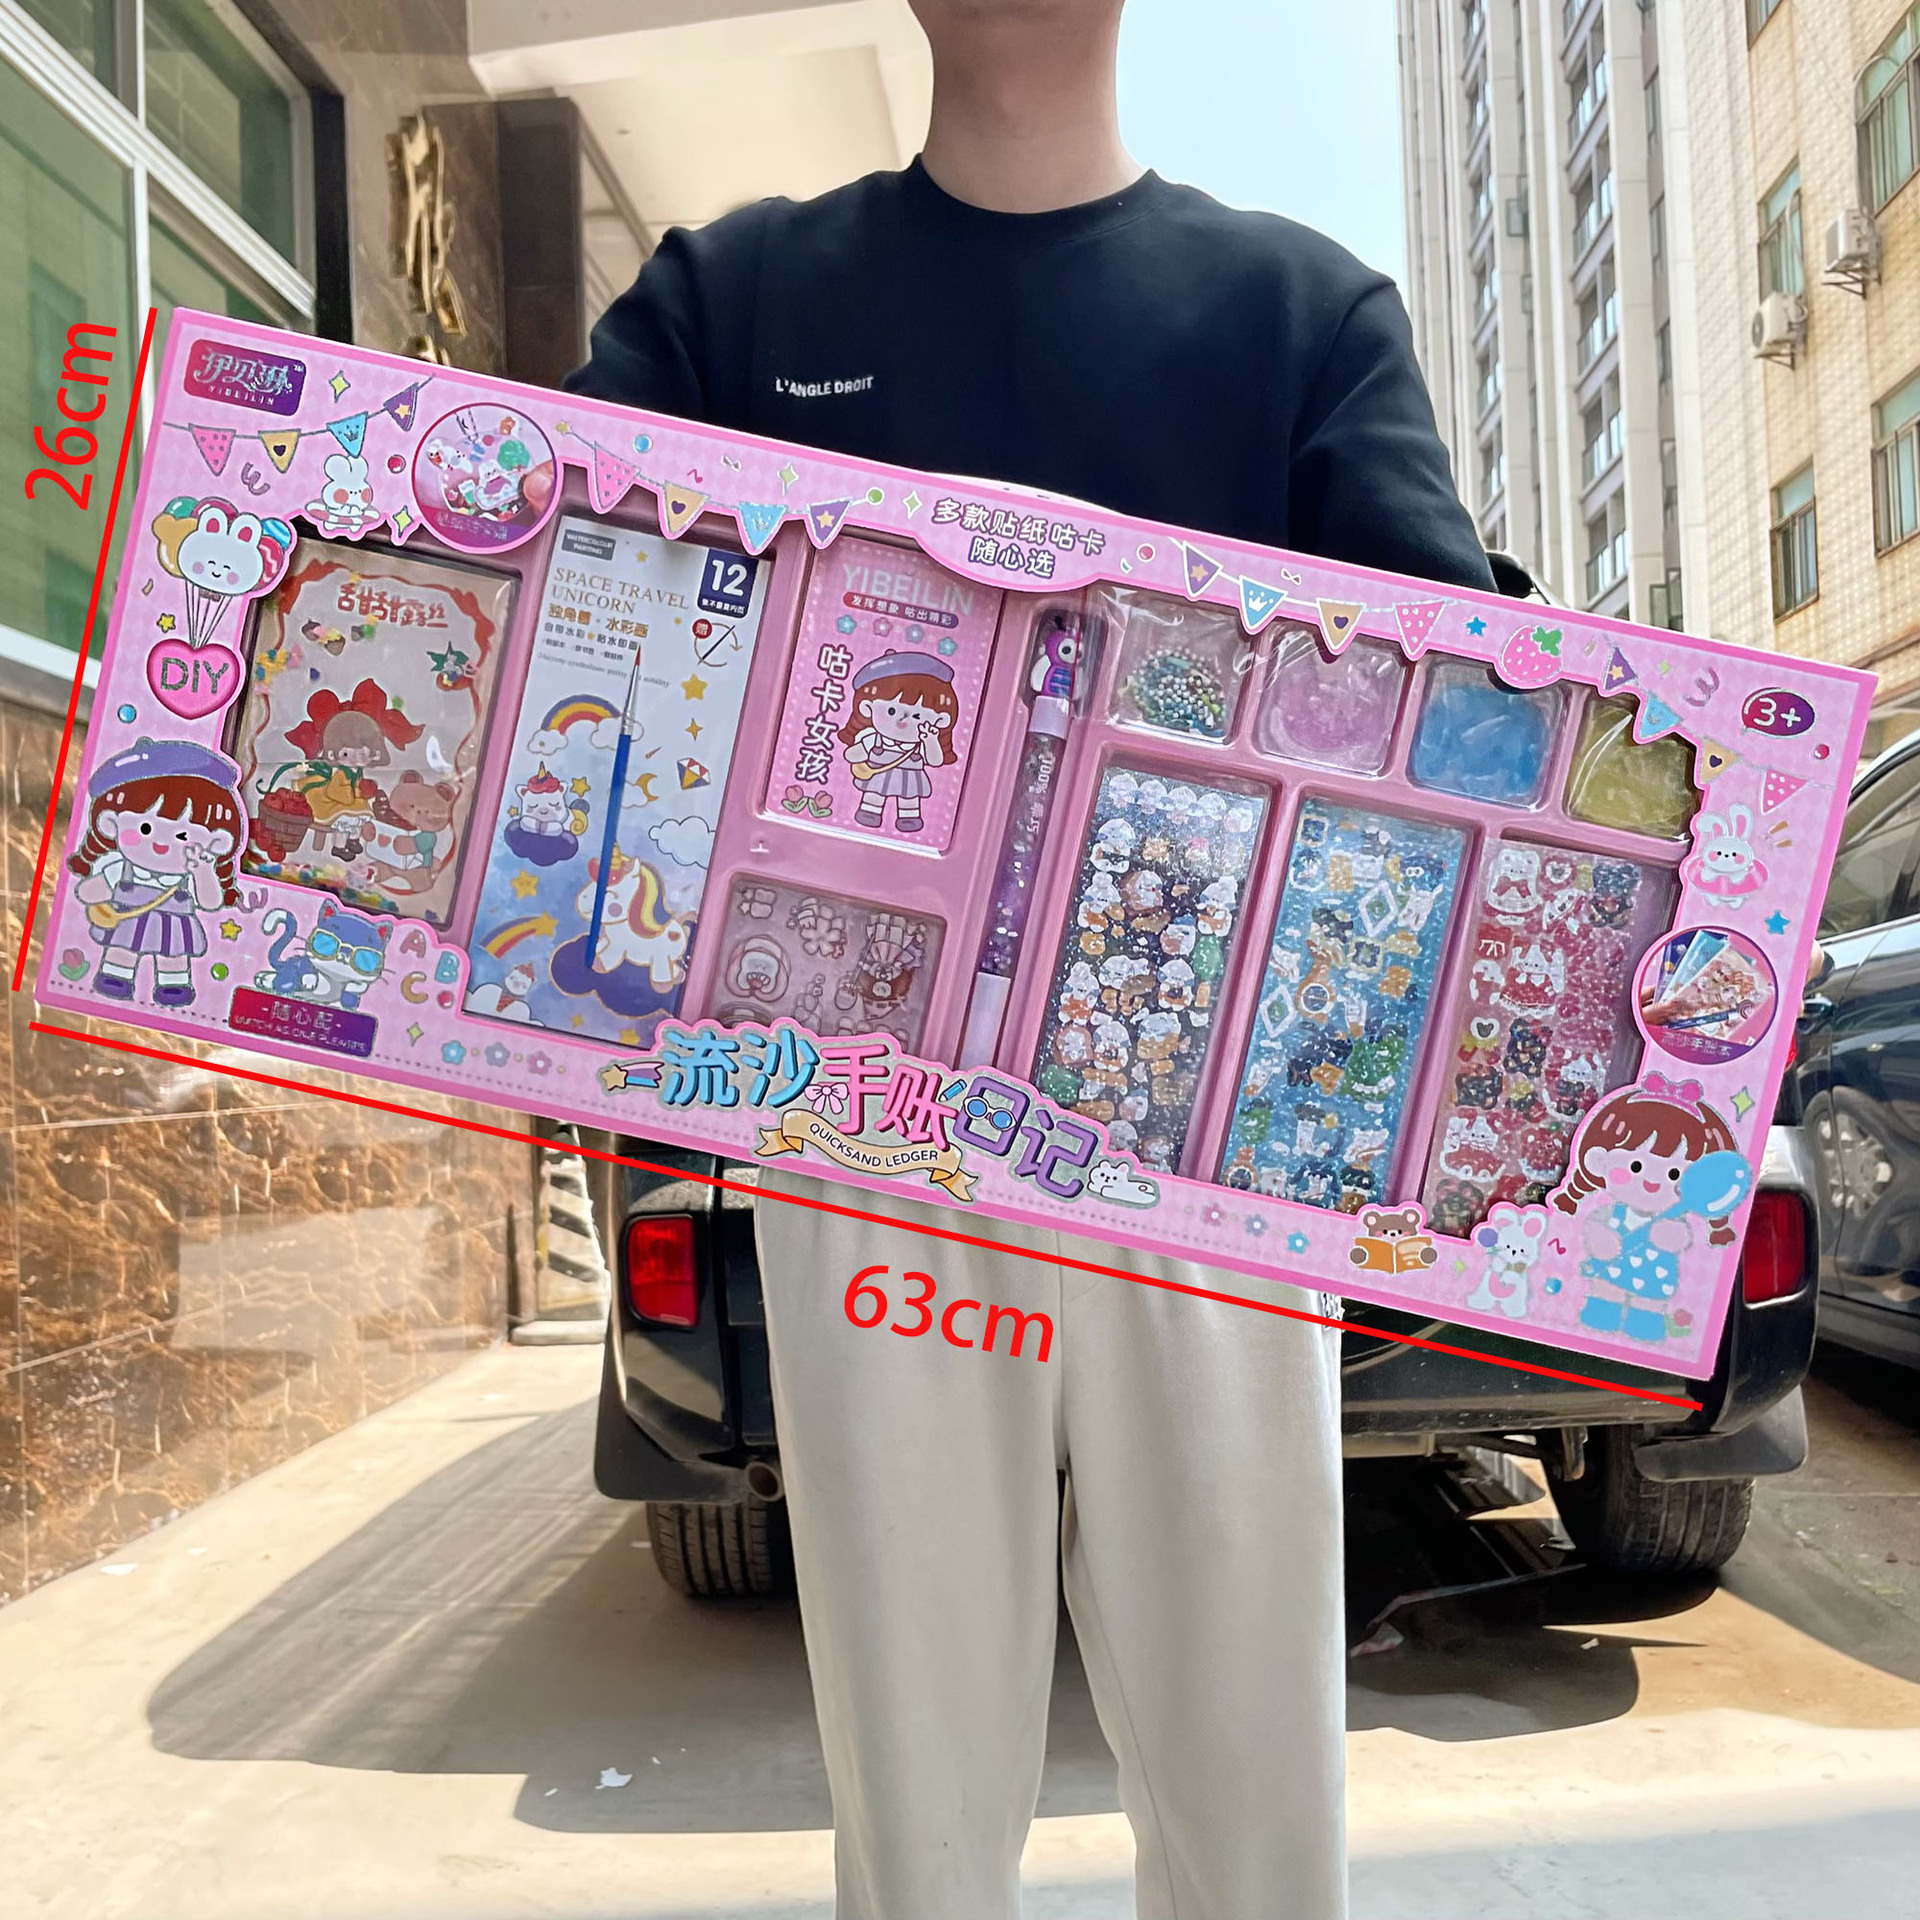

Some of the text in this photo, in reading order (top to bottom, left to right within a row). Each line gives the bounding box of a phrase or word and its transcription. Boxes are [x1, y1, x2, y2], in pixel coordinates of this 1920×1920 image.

[775, 376, 873, 397] L'ANGLE DROIT
[932, 498, 1106, 555] 多款贴纸咕卡
[712, 559, 747, 596] 12
[969, 537, 1054, 579] 随心选
[551, 585, 636, 615] UNICORN
[553, 567, 690, 610] SPACE TRAVEL
[843, 563, 974, 616] YIBEILIN
[160, 657, 230, 694] DIY
[795, 643, 853, 785] 咕卡女孩
[1752, 696, 1801, 728] 3+
[664, 1029, 1098, 1198] 流沙手账日记
[809, 1122, 939, 1168] QUICKSAND LEDGER
